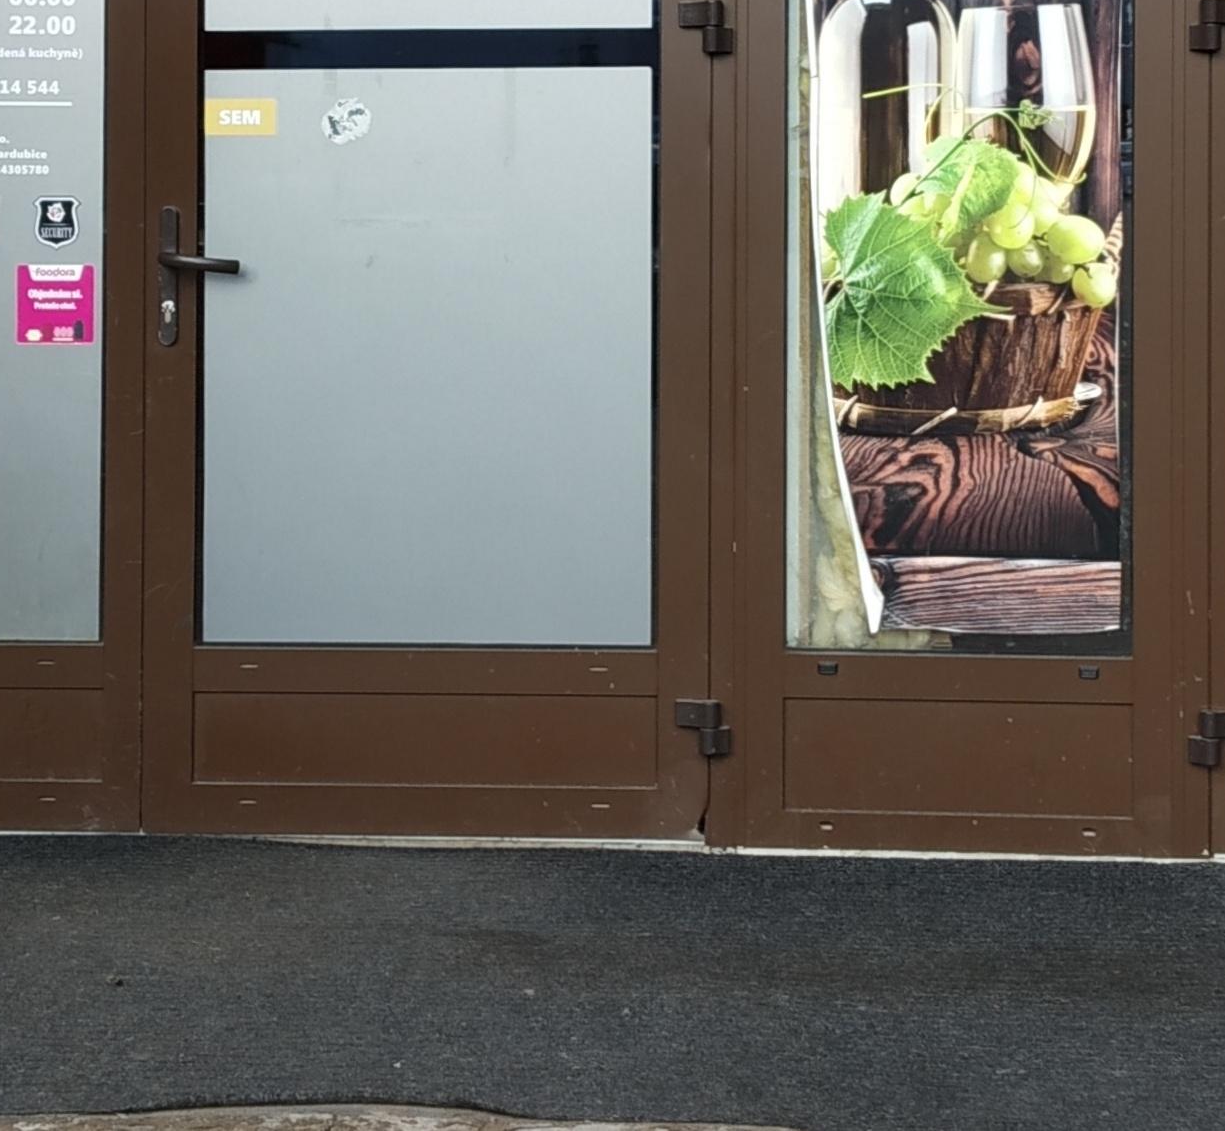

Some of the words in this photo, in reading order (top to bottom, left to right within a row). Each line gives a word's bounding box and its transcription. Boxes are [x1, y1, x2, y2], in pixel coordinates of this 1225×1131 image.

[8, 16, 76, 35] 22.00
[28, 47, 83, 61] kuchyně)
[26, 80, 61, 96] 544
[218, 109, 261, 126] SEM
[40, 227, 73, 239] SECURITY
[34, 267, 76, 277] foodora
